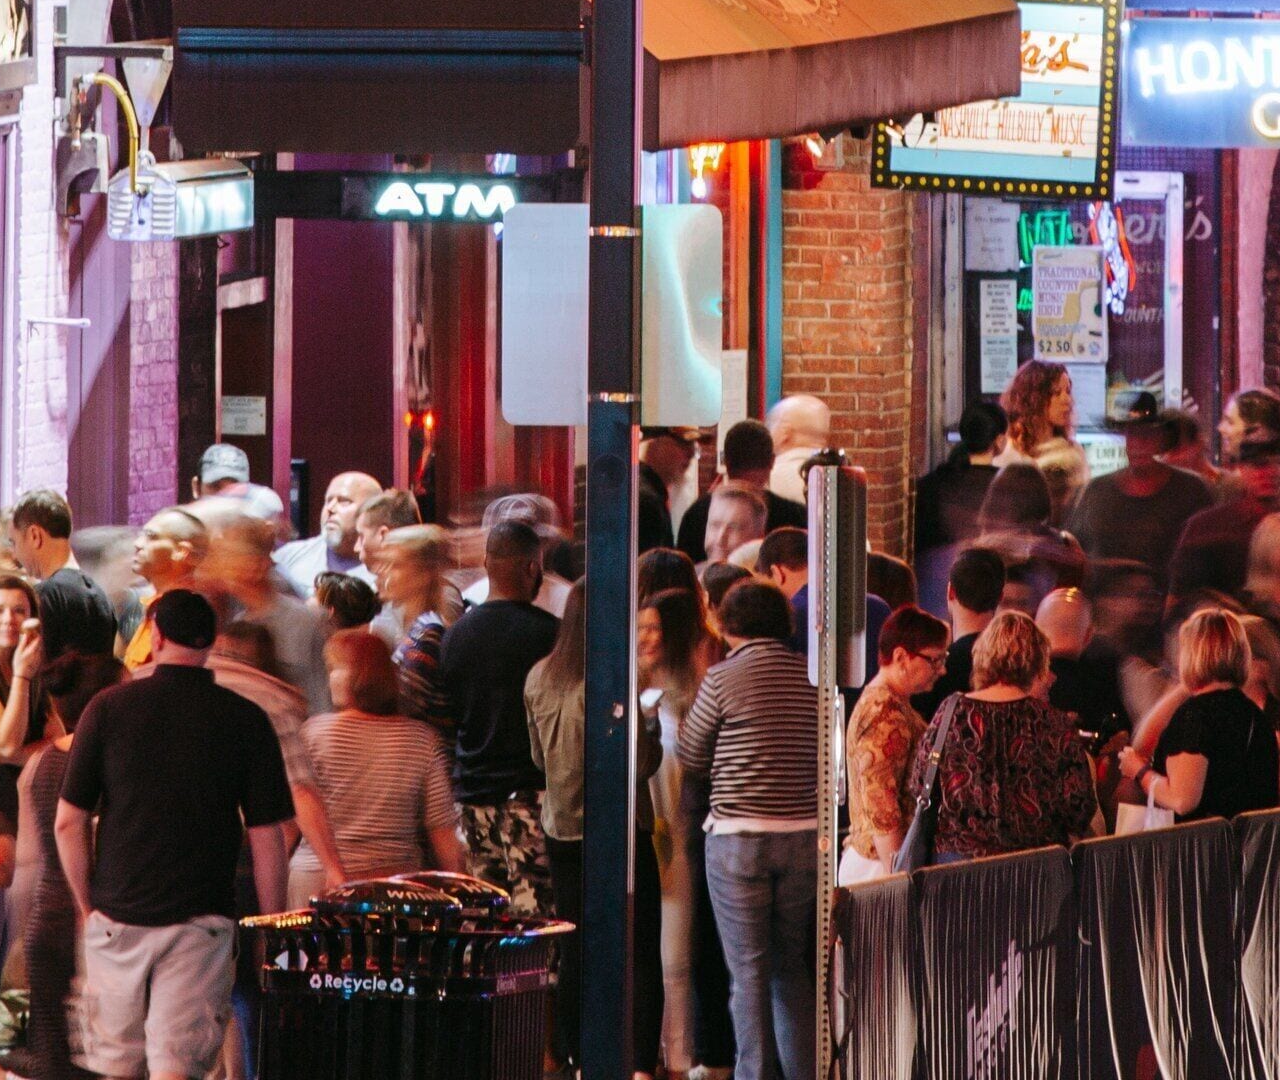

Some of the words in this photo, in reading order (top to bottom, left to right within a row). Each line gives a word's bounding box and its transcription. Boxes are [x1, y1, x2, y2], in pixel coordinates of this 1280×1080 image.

[1050, 111, 1088, 147] MUSIC
[375, 182, 517, 218] ATM
[1037, 266, 1100, 281] TRADITIONAL
[325, 973, 387, 994] Recycle
